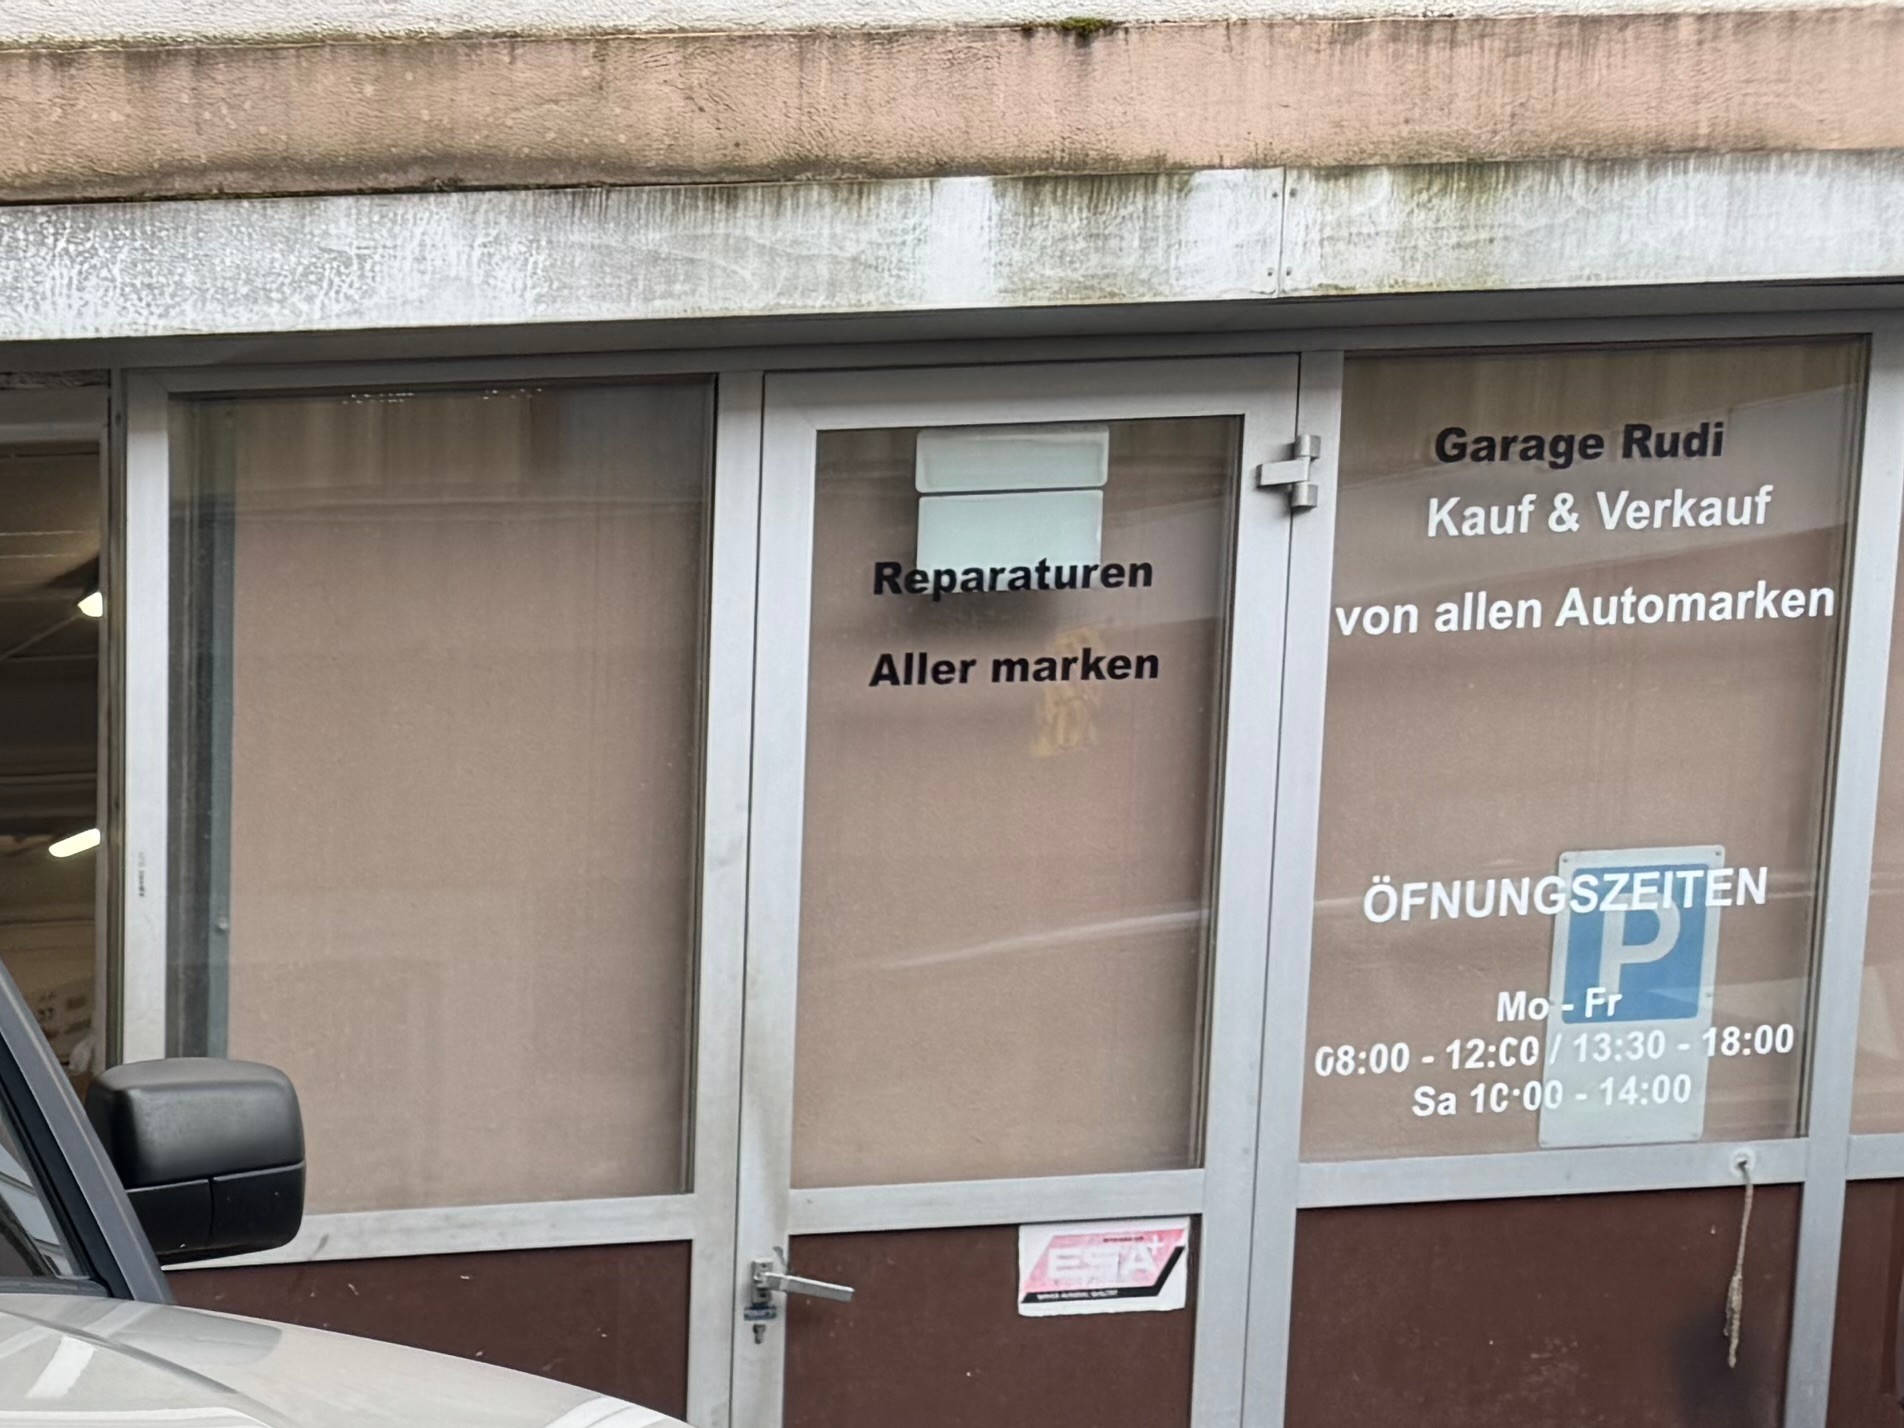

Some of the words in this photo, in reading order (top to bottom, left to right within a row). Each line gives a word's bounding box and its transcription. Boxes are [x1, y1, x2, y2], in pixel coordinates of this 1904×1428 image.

[1434, 425, 1605, 469] Garage
[1622, 422, 1725, 461] Rudi
[1427, 493, 1535, 538] Kauf
[1548, 491, 1580, 533] &
[1597, 485, 1774, 530] Verkauf
[873, 556, 1154, 602] Reparaturen
[1335, 601, 1418, 638] von
[1433, 591, 1542, 633] allen
[1554, 580, 1835, 629] Automarken
[869, 652, 976, 688] Aller
[991, 648, 1160, 684] marken
[1364, 867, 1769, 924] ÖFNUNGSZEITEN
[1598, 896, 1681, 995] P
[1496, 991, 1549, 1022] Mo
[1585, 988, 1622, 1017] Fr
[1315, 1043, 1410, 1077] 08:00
[1573, 1030, 1666, 1063] 13:30
[1703, 1024, 1794, 1057] 18:00
[1412, 1086, 1457, 1117] Sa
[1600, 1074, 1691, 1106] 14:00
